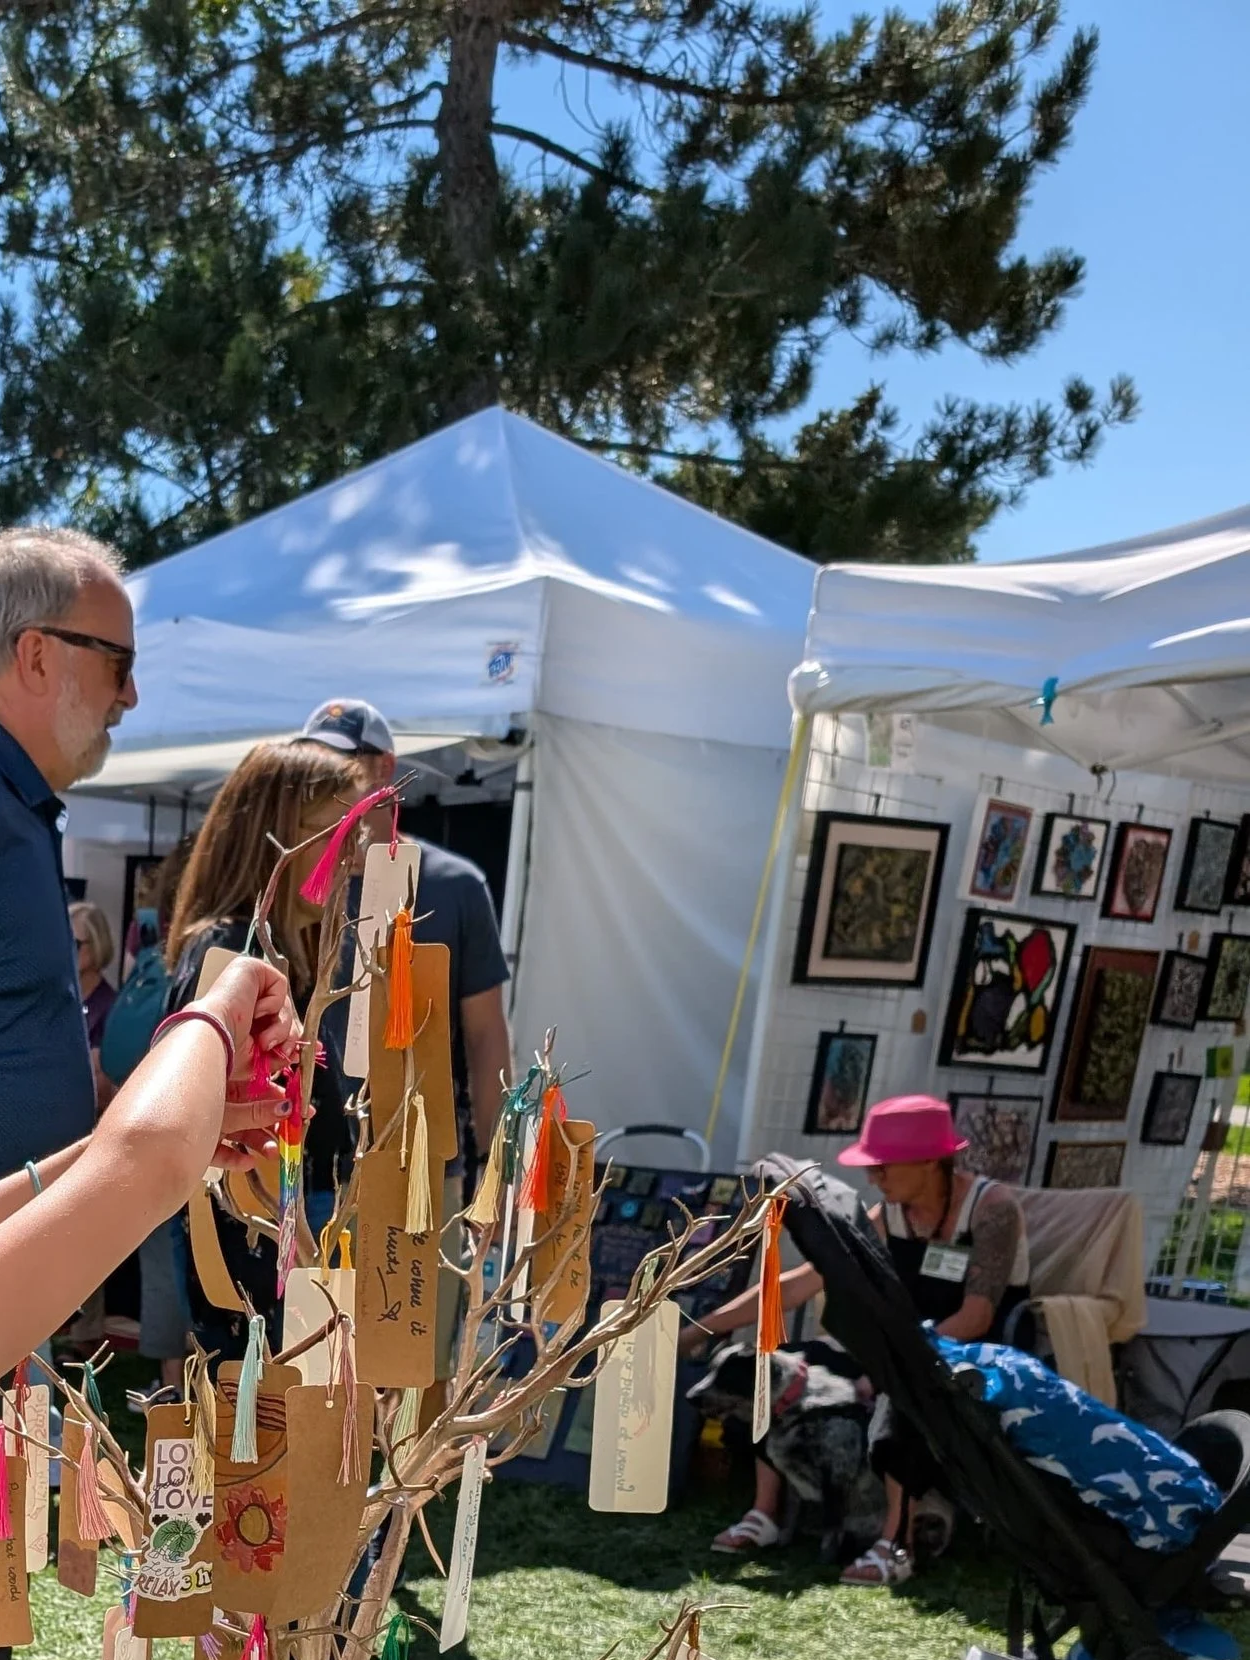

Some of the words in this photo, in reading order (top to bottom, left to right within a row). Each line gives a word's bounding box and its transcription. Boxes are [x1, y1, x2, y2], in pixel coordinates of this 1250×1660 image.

[386, 1225, 404, 1276] hurts
[570, 1269, 583, 1288] be
[410, 1321, 427, 1336] it
[154, 1488, 214, 1509] LOVE
[8, 1566, 22, 1602] words
[134, 1573, 180, 1597] RELAX
